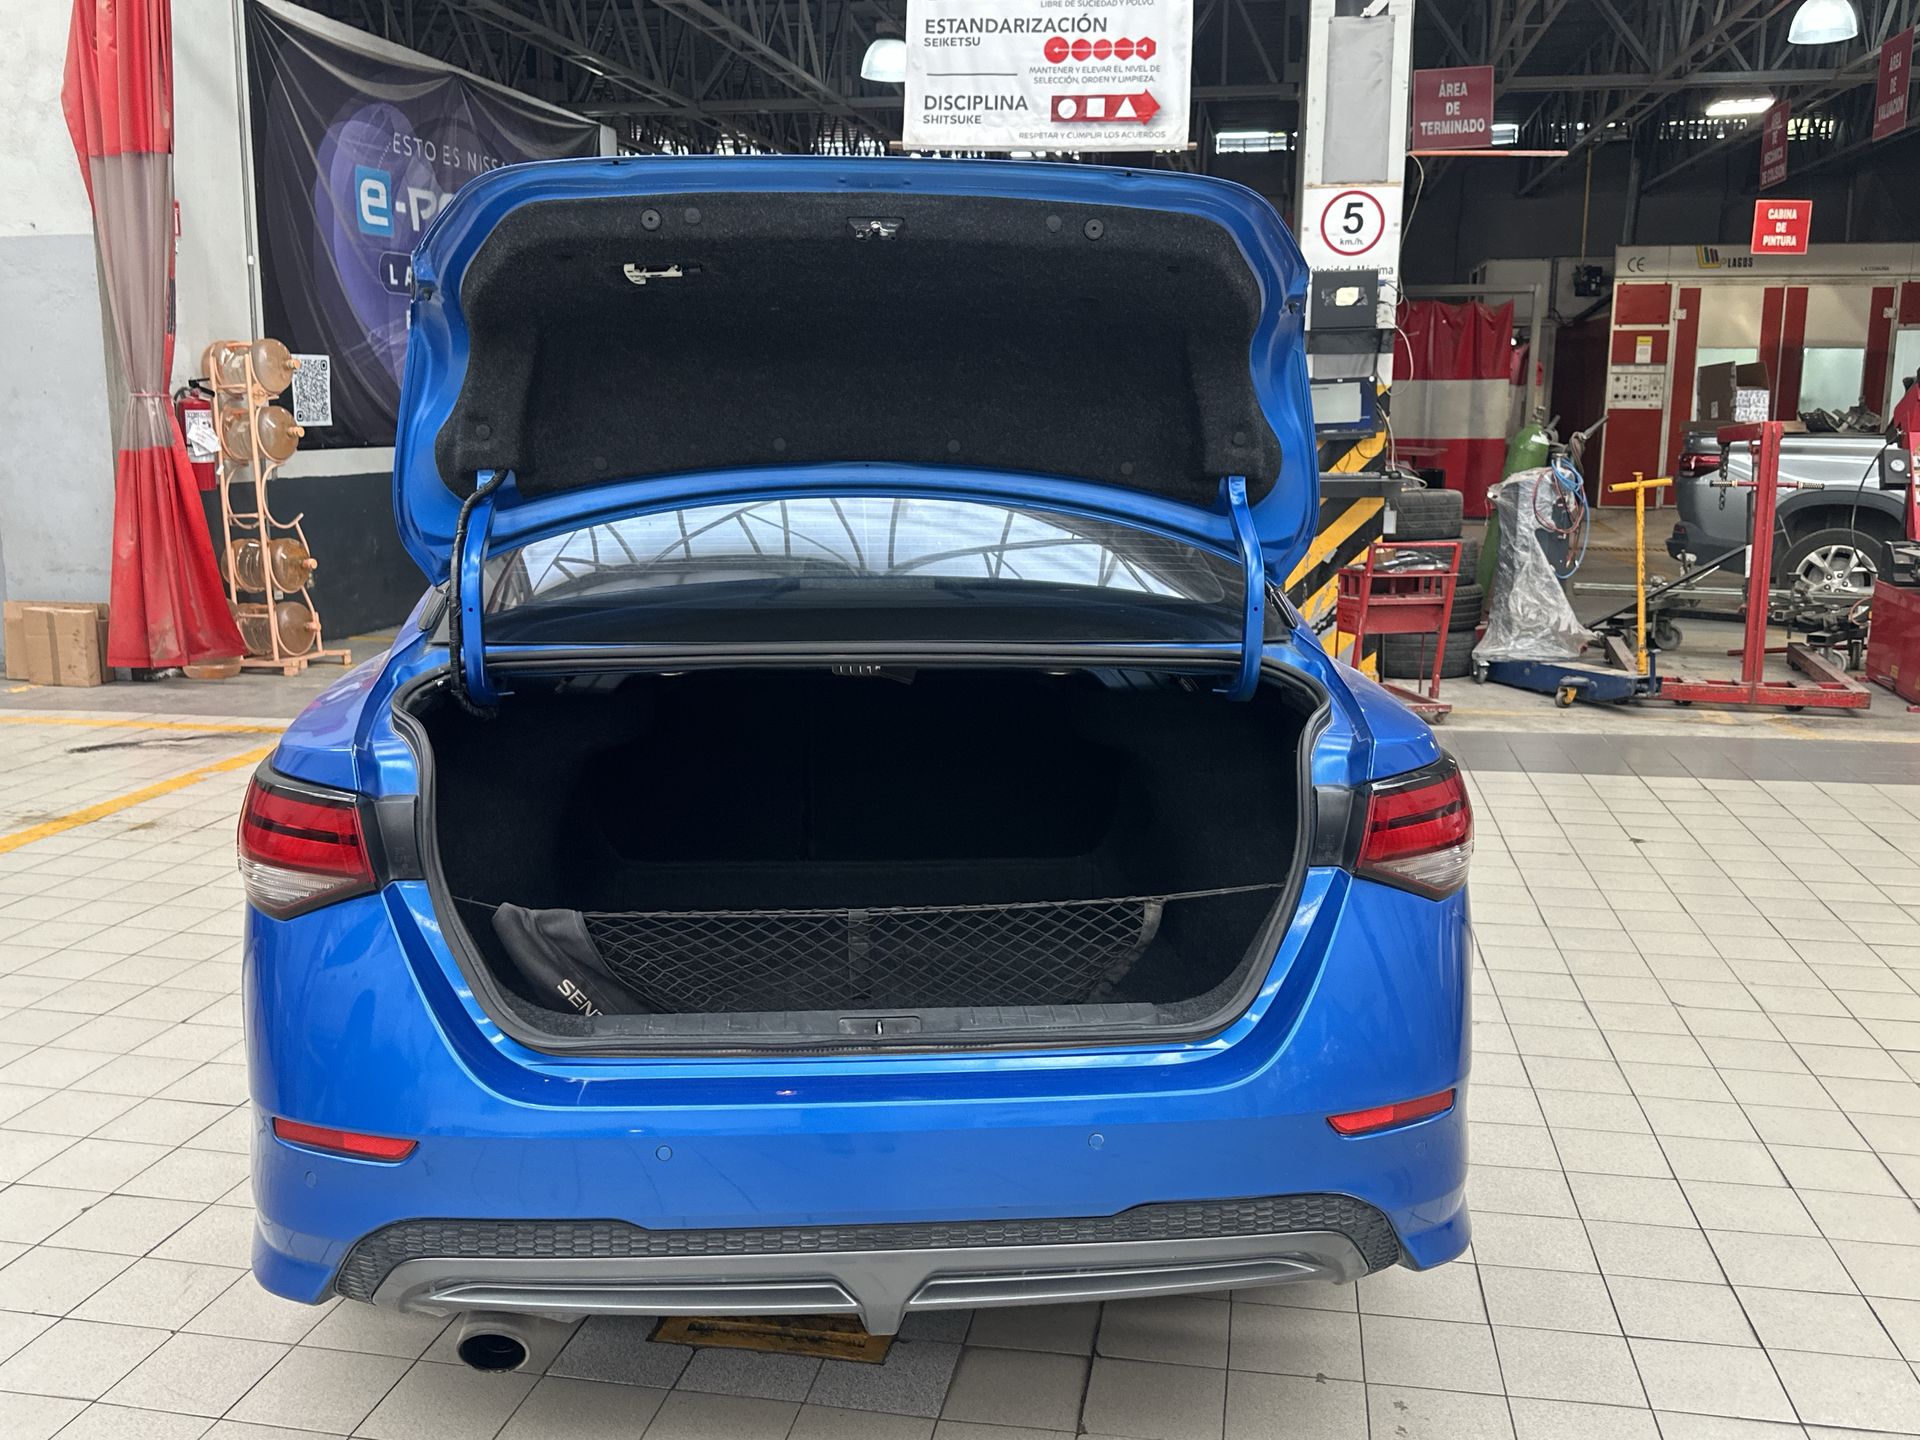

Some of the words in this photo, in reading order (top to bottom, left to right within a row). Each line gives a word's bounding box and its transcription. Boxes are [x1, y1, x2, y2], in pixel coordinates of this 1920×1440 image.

[925, 13, 1107, 34] ESTANDARIZACIÓN
[923, 36, 981, 47] SEIKETSU
[1029, 66, 1073, 74] MANTENER
[1075, 66, 1081, 74] Y
[1082, 65, 1112, 73] ELEVAR
[1114, 65, 1122, 73] EL
[1125, 65, 1148, 73] NIVEL
[1150, 64, 1161, 73] DE
[1081, 75, 1110, 84] ORDEN
[1111, 75, 1117, 83] Y
[1438, 80, 1468, 98] ÁREA
[924, 94, 1028, 111] DISCIPLINA
[1445, 101, 1460, 116] DE
[922, 114, 982, 125] SHITSUKE
[1420, 118, 1486, 136] TERMINADO
[1019, 131, 1058, 139] RESPETAR
[1060, 131, 1065, 139] Y
[1066, 131, 1102, 139] CUMPLIR
[1104, 131, 1119, 139] LOS
[1121, 130, 1166, 139] ACUERDOS
[393, 132, 436, 161] ESTO
[443, 145, 460, 168] ES
[1342, 202, 1364, 235] 5
[1768, 208, 1797, 220] CABINA
[1775, 221, 1787, 233] DE
[1762, 235, 1797, 247] PINTURA
[1627, 257, 1645, 272] CE
